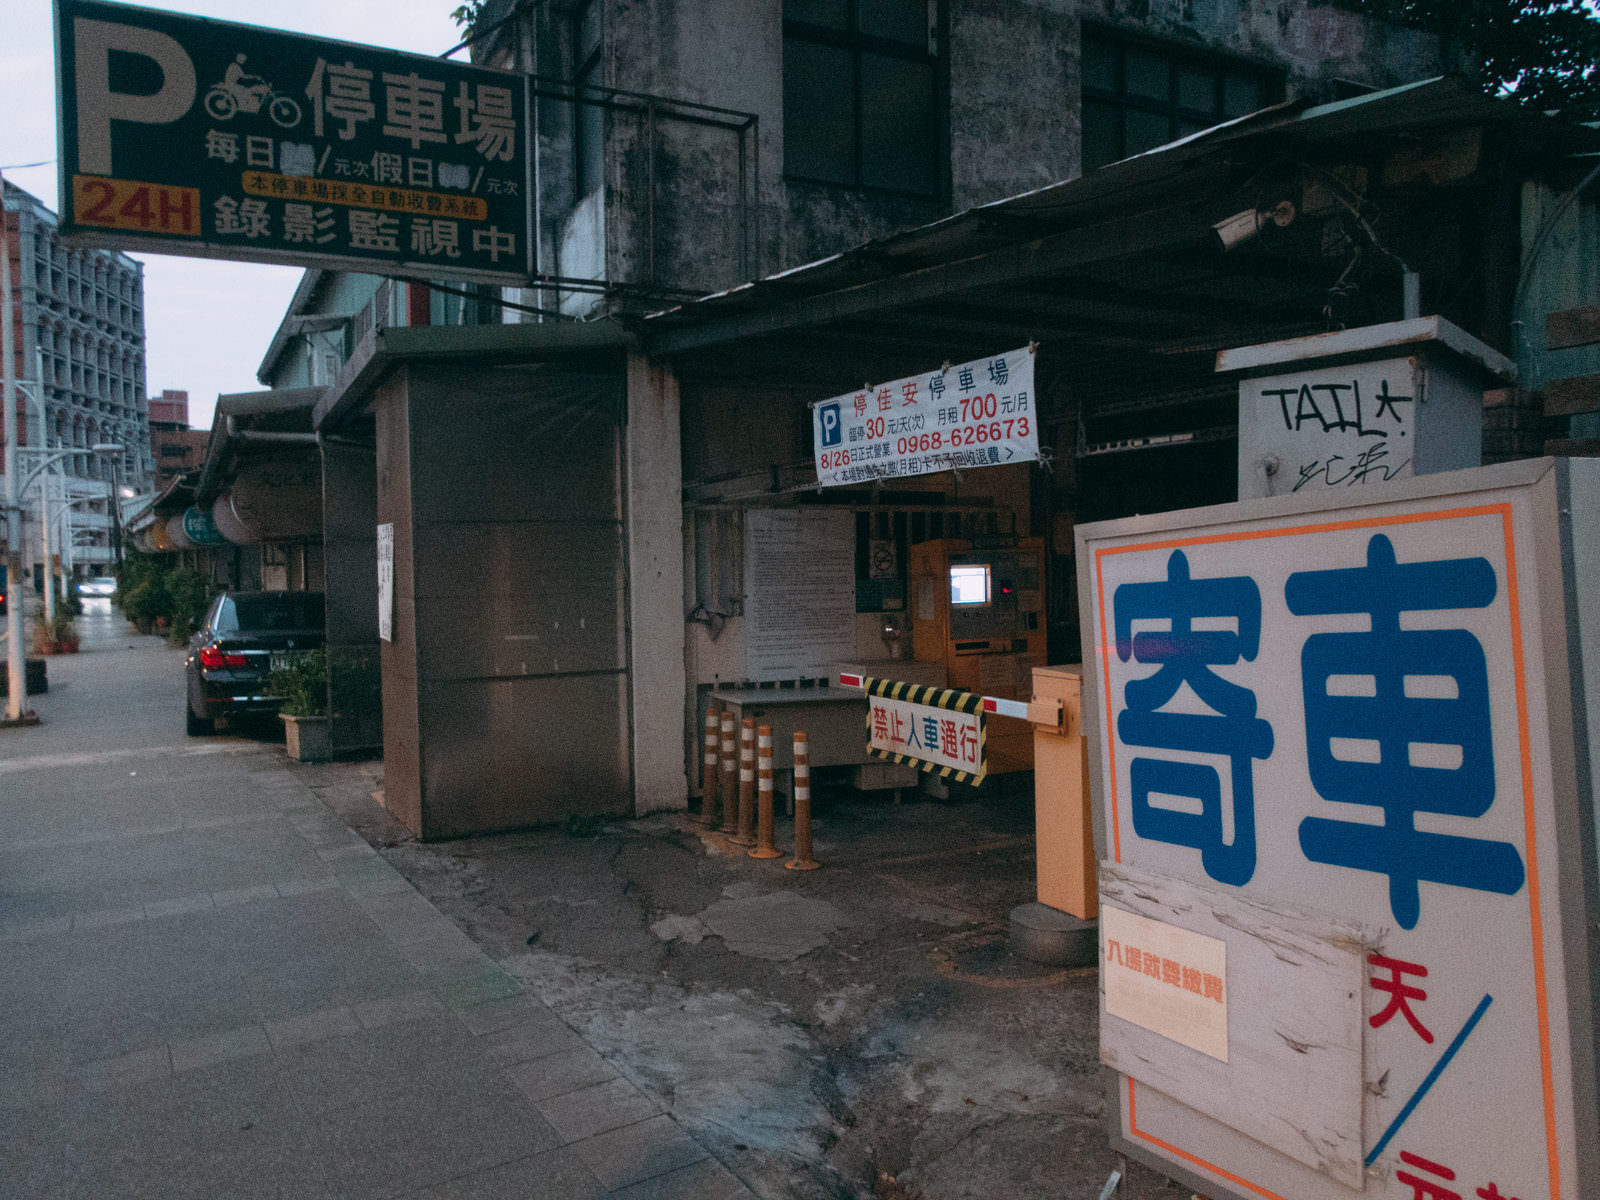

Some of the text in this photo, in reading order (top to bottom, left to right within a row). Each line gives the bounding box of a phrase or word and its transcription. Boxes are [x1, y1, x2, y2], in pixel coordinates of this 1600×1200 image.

[74, 17, 197, 176] P
[305, 57, 516, 162] 停車場
[82, 181, 193, 231] 24H
[214, 195, 516, 262] 錄影監視中
[824, 409, 837, 443] P
[897, 417, 1030, 455] 0968-626673
[873, 705, 978, 763] 禁止人車通行
[1113, 533, 1525, 931] 寄車
[1107, 939, 1224, 1005] 入場就要繳費
